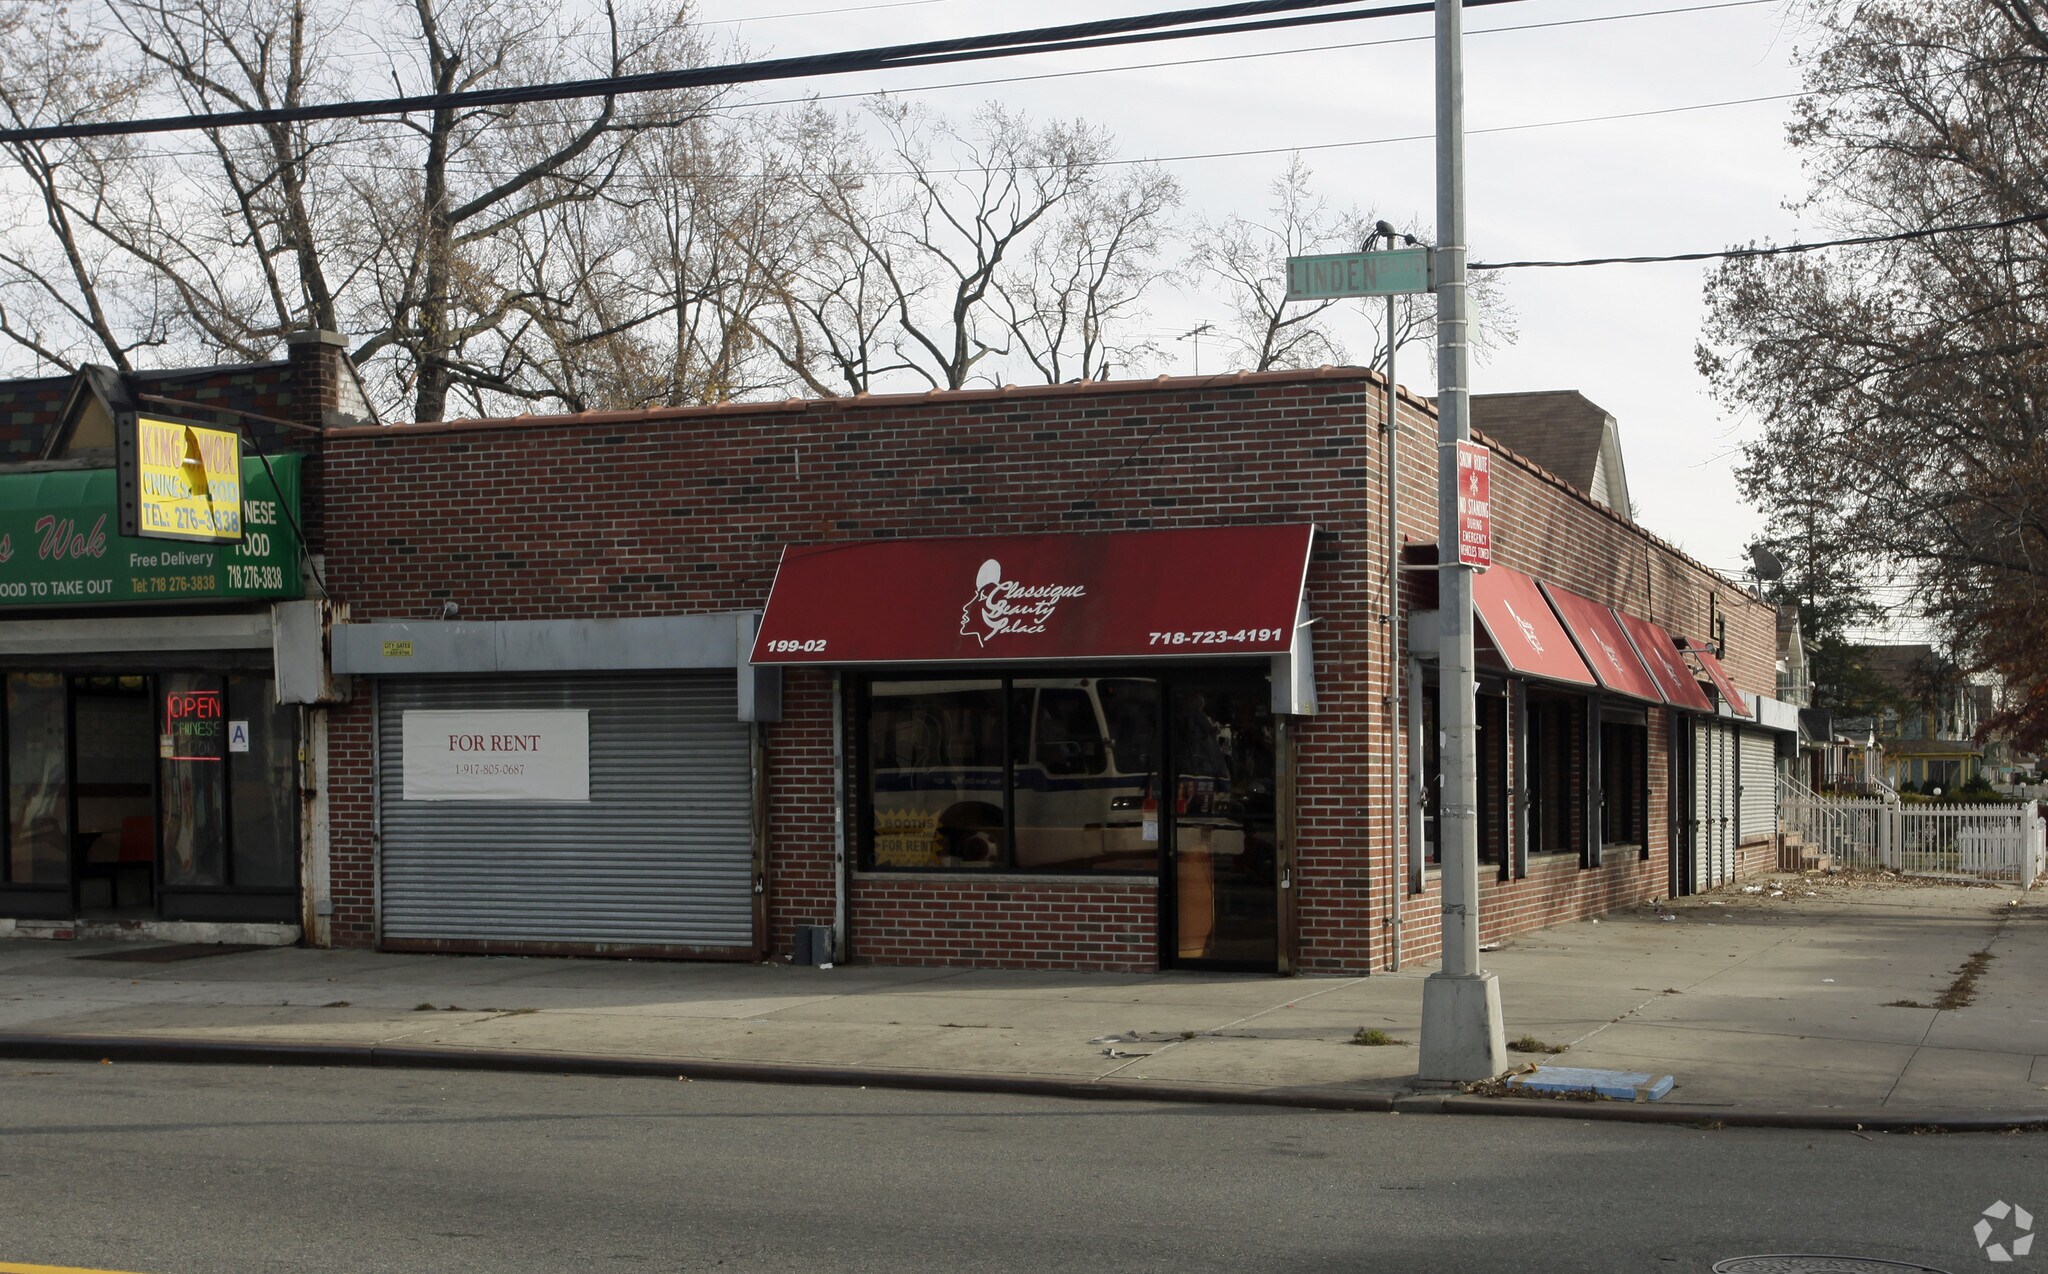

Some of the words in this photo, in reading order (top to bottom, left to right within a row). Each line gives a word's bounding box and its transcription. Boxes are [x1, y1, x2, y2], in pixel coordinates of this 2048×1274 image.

[1289, 258, 1377, 294] LINDEN
[142, 425, 181, 469] KING
[200, 433, 236, 475] WOK
[1459, 450, 1472, 469] SNOW
[1474, 454, 1488, 473] ROUTE
[143, 472, 192, 500] CHINES
[197, 480, 238, 503] OOD
[1459, 496, 1466, 514] NO
[1468, 498, 1489, 519] STANDING
[175, 506, 239, 533] 276-3838
[1466, 517, 1482, 531] DURING
[34, 513, 107, 560] Wok
[1462, 530, 1487, 546] EMERGENCY
[130, 553, 158, 567] Free
[161, 551, 214, 567] Delivery
[1461, 544, 1477, 558] VEHICLES
[1478, 547, 1490, 560] TOWED
[149, 576, 166, 593] 718
[169, 575, 215, 592] 276-3838
[227, 565, 242, 589] 718
[243, 565, 283, 590] 276-3838
[30, 581, 47, 596] TO
[50, 580, 84, 595] TAKE
[86, 579, 113, 594] OUT
[986, 580, 1087, 610] Classique
[989, 599, 1056, 624] Beauty
[982, 614, 1047, 641] Palace
[1149, 628, 1282, 645] 718-723-4191
[767, 639, 827, 653] 199-02
[171, 696, 221, 718] OPEN
[171, 721, 221, 737] CHINESE
[232, 725, 245, 743] A
[448, 734, 486, 752] FOR
[490, 734, 541, 752] RENT
[455, 763, 525, 776] 1-917-805-0687
[884, 818, 935, 829] BOOTHS
[881, 840, 903, 852] FOR
[905, 840, 934, 852] RENT
